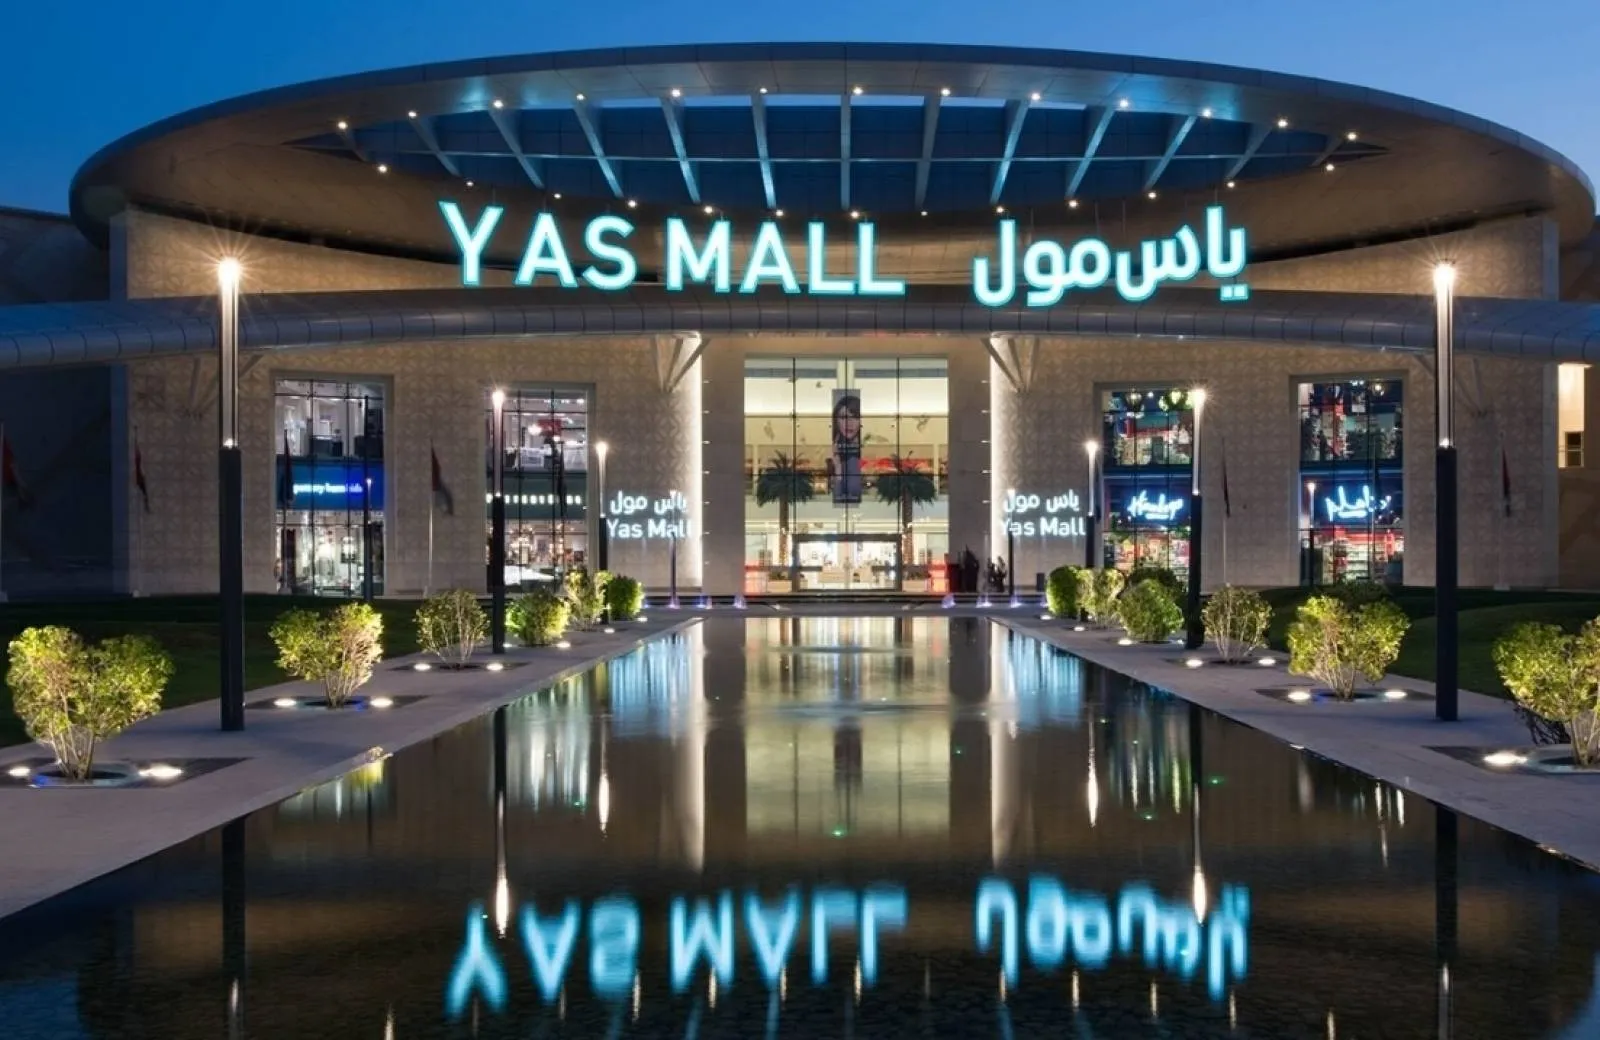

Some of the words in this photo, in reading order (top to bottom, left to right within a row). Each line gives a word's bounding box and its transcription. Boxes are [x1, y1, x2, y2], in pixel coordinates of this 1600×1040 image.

[439, 201, 638, 291] YAS
[665, 217, 906, 295] MALL
[1116, 205, 1249, 302] ياس
[973, 219, 1112, 307] مول
[610, 490, 648, 515] مول
[1003, 488, 1040, 514] مول
[1045, 488, 1080, 513] ياس
[606, 518, 644, 539] Yas
[647, 518, 693, 539] Mall
[1000, 517, 1035, 537] Yas
[1040, 516, 1087, 537] Mall
